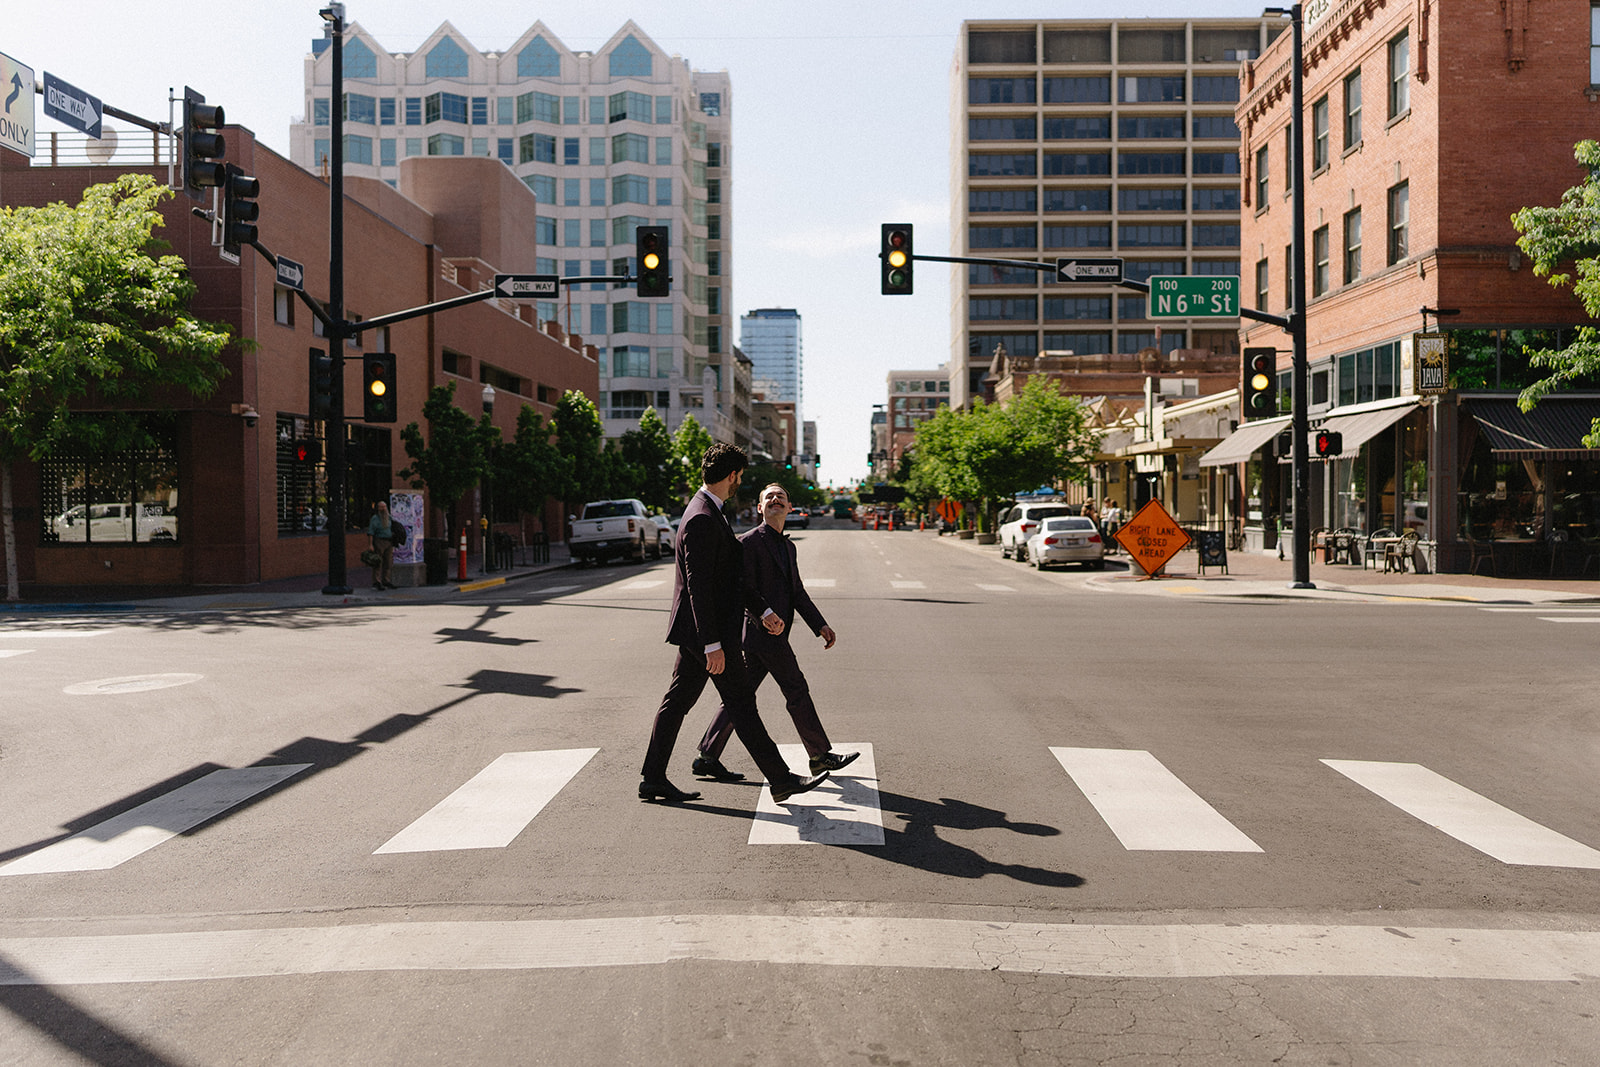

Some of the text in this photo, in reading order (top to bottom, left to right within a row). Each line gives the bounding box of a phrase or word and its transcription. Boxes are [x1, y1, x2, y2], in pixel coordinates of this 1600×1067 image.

[50, 89, 86, 118] ONE WAY
[0, 117, 29, 146] ONLY
[1075, 266, 1116, 275] ONE WAY
[513, 283, 552, 291] ONE WAY
[1159, 280, 1231, 291] 100 200
[1158, 294, 1171, 313] N
[1210, 293, 1232, 313] St
[1421, 367, 1442, 388] JAVA
[1129, 526, 1177, 536] RIGHT LANE
[1137, 538, 1168, 547] CLOSED
[1139, 549, 1165, 558] AHEAD
